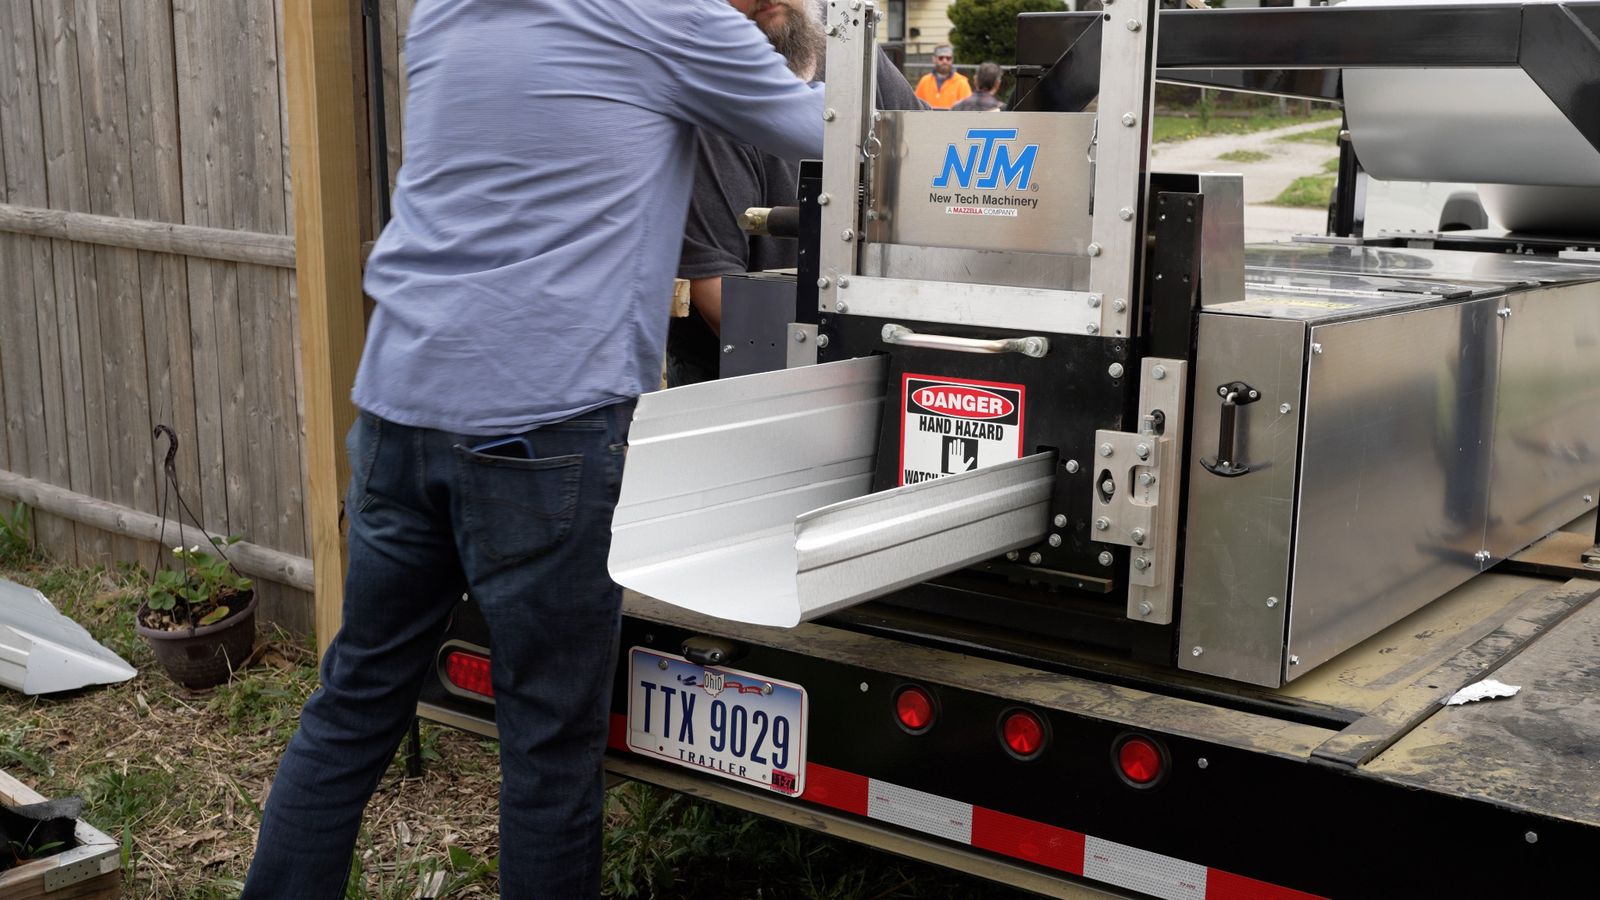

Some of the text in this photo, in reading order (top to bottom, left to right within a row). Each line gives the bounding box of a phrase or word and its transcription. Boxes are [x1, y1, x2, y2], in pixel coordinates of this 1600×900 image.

[931, 128, 1040, 191] NTM
[929, 192, 1039, 209] New Tech Machinery
[953, 207, 983, 215] MAZZELLA
[984, 208, 1016, 216] COMPANY
[921, 389, 1004, 415] DANGER
[919, 415, 1004, 442] HAND HAZARD
[704, 673, 724, 691] Ohio
[641, 680, 790, 770] TTX 9029
[678, 748, 748, 778] TRAILER
